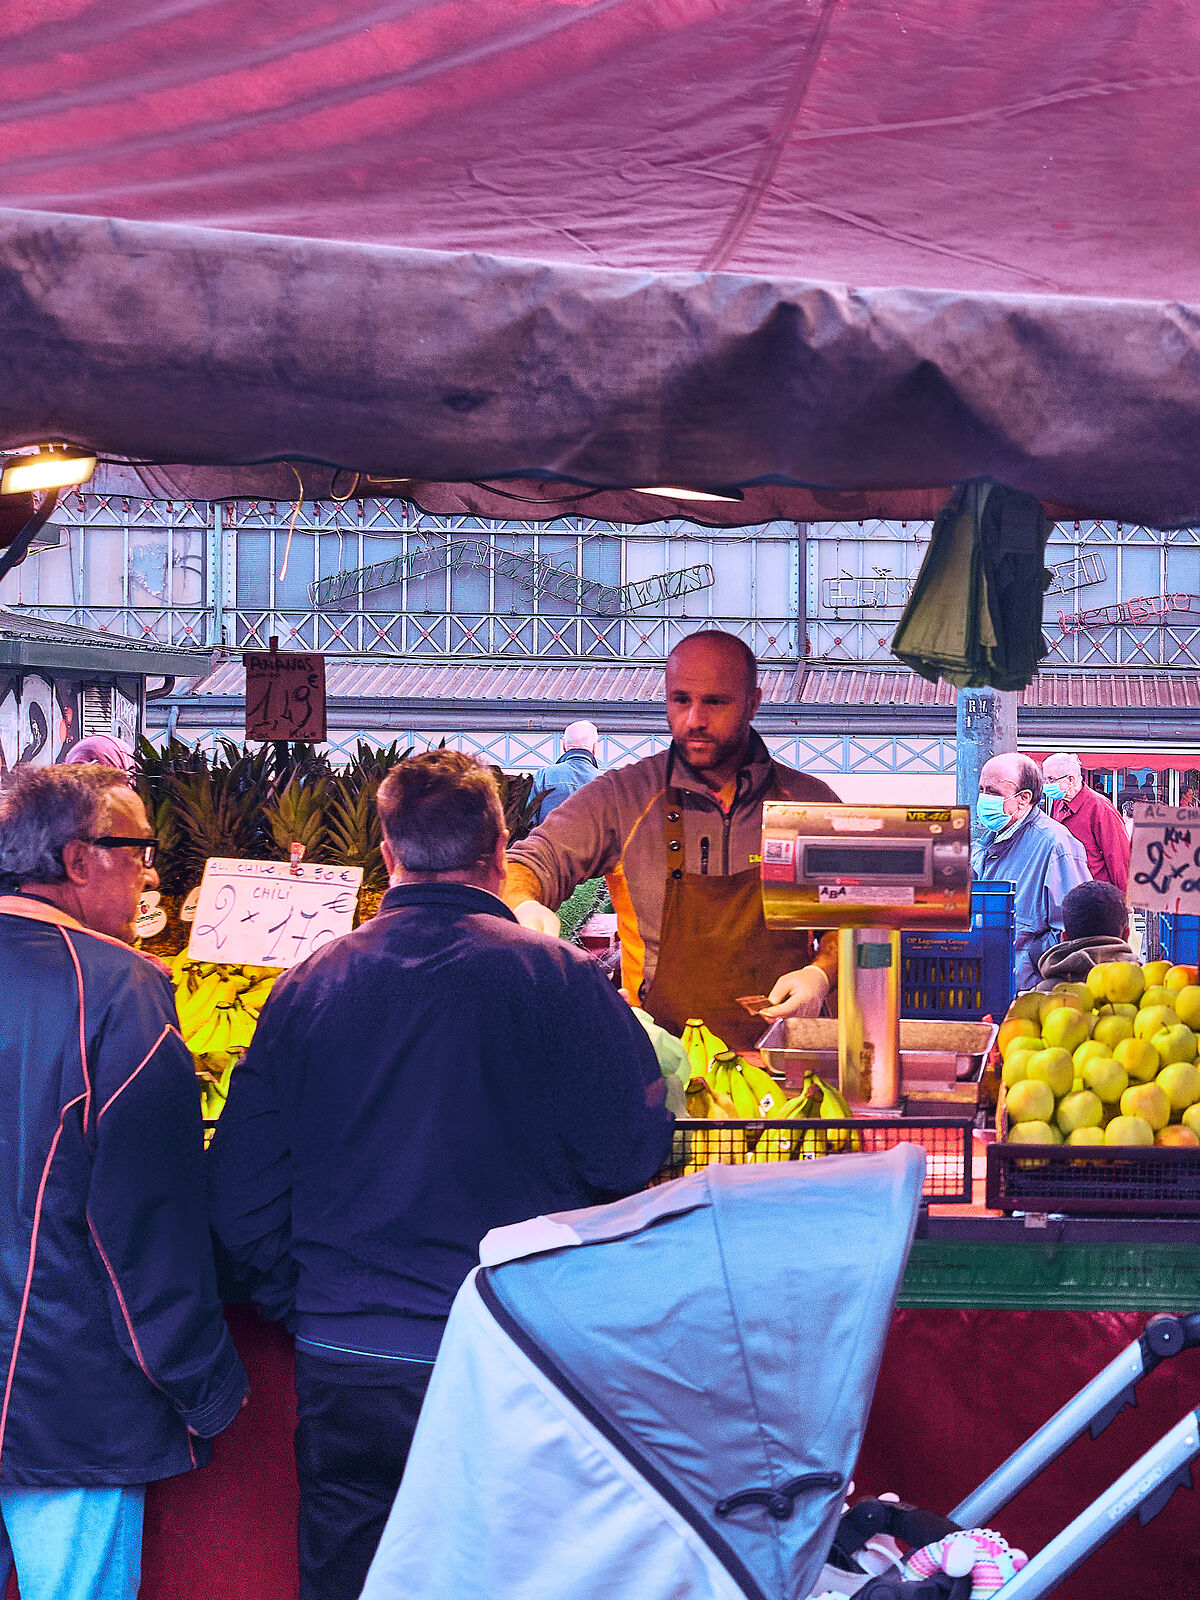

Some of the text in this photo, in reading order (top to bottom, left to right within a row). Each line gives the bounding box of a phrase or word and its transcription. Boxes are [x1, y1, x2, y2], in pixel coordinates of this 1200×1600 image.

[251, 656, 314, 672] ANANAS
[1144, 805, 1166, 819] AL
[1134, 841, 1170, 894] 2
[253, 886, 290, 900] CHILI
[196, 884, 237, 949] 2
[321, 892, 356, 914] €
